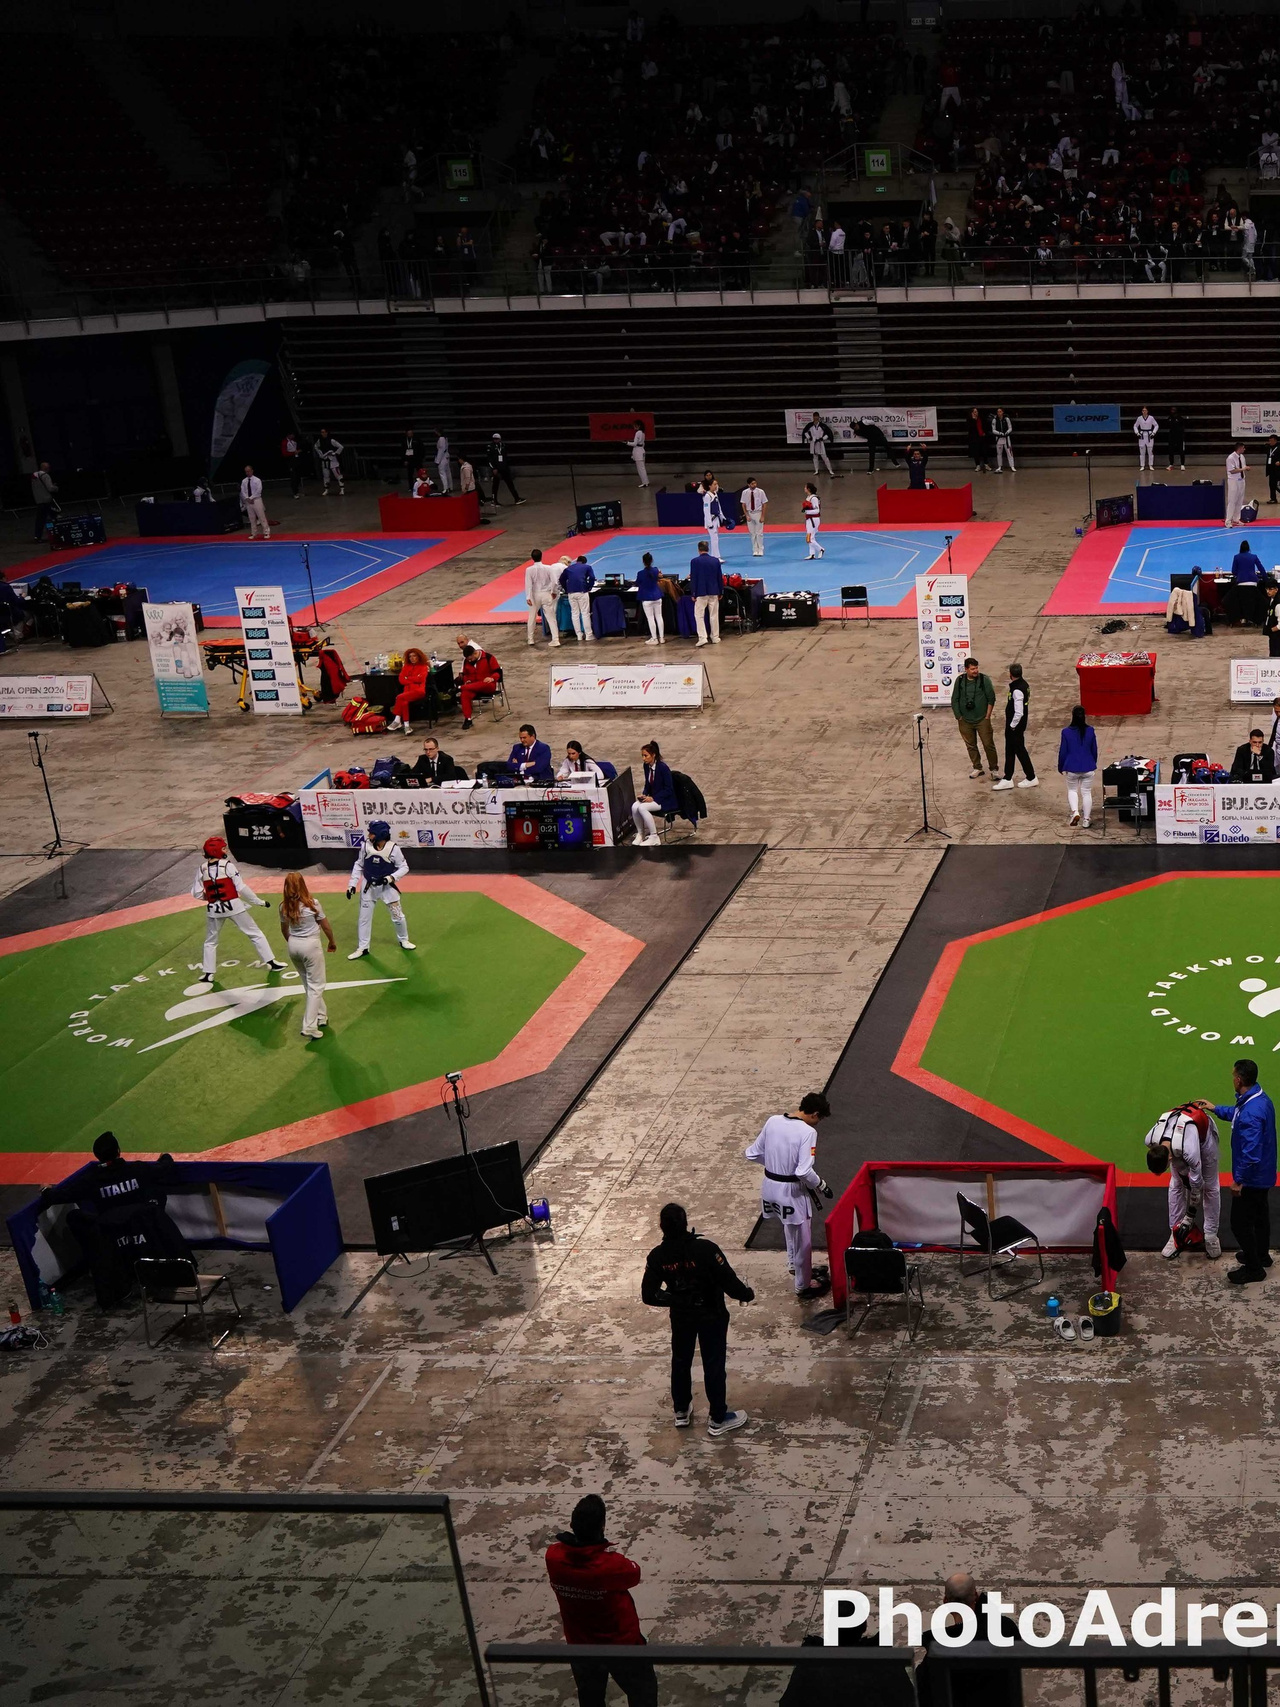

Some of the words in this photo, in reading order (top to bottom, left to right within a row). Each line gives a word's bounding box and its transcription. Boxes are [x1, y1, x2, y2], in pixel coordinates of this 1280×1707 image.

[871, 159, 885, 167] 114
[884, 414, 905, 422] 2026
[1075, 415, 1109, 423] KPNP
[491, 796, 497, 804] 4
[362, 802, 448, 815] BULGARIA
[452, 801, 486, 814] OPE
[523, 821, 532, 835] 0
[565, 820, 574, 834] 3
[1221, 834, 1249, 842] Daedo
[207, 900, 234, 913] FIN
[68, 1011, 135, 1048] WORLD
[1150, 1008, 1255, 1045] WORLD
[100, 1178, 140, 1199] ITALIA
[762, 1199, 795, 1220] ESP
